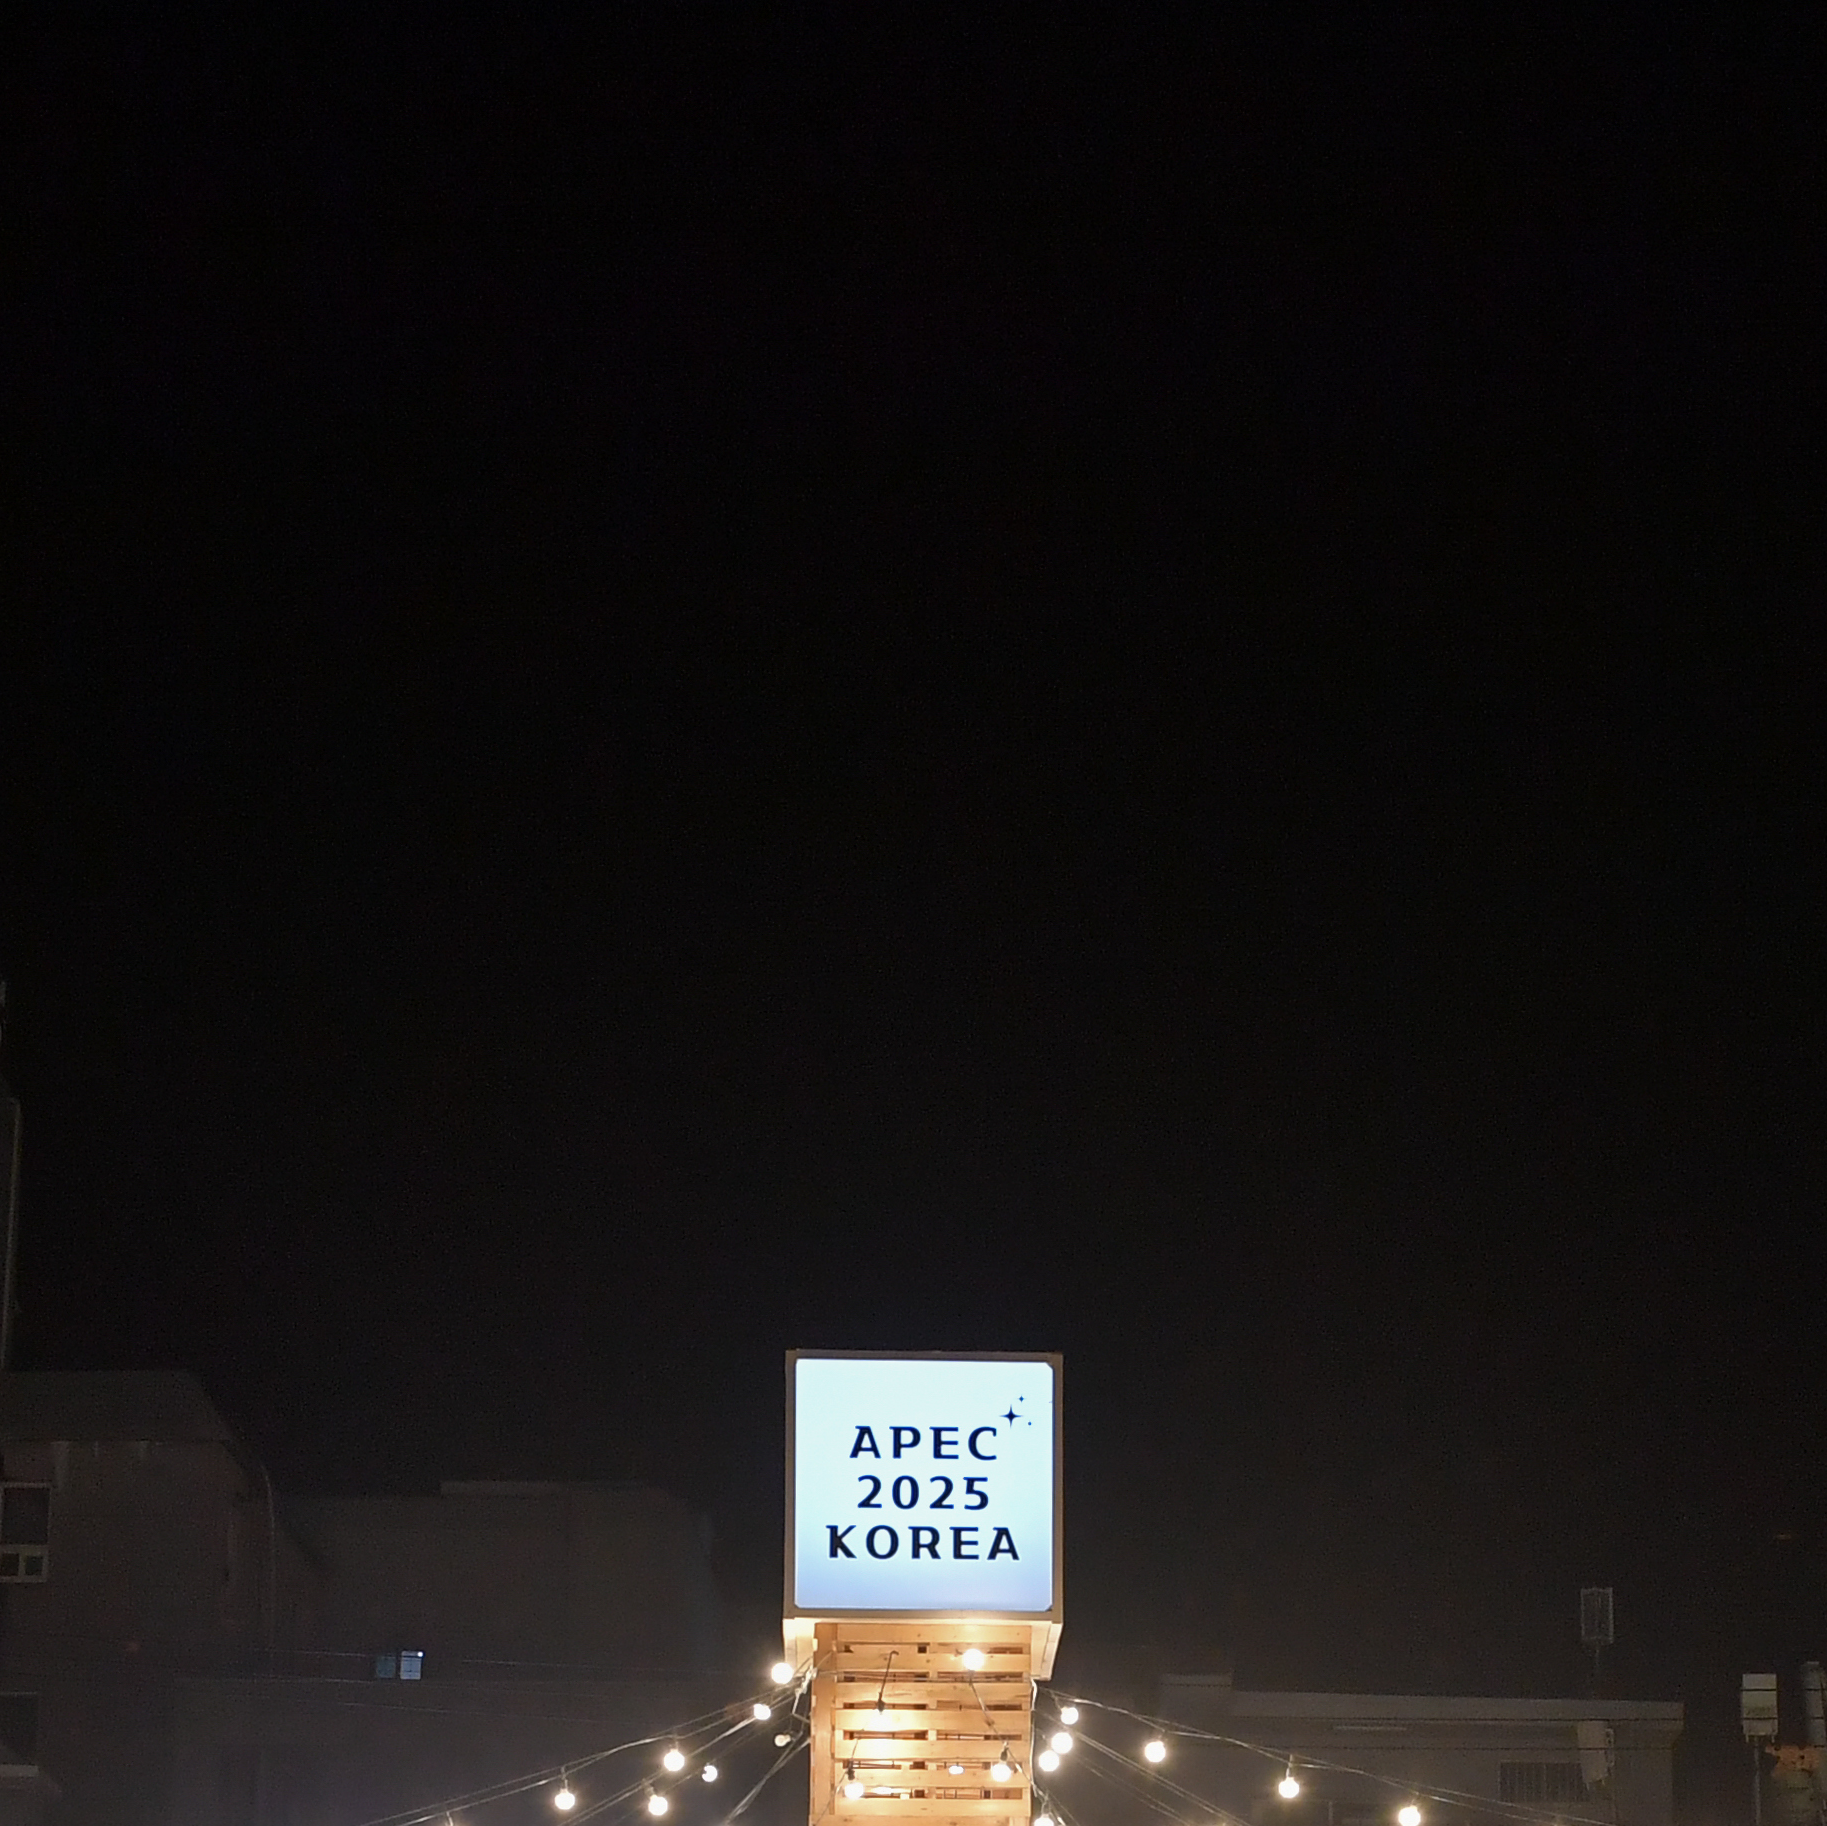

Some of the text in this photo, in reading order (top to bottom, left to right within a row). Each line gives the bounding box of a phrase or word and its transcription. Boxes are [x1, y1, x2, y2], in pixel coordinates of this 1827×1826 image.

[849, 1425, 998, 1461] APEC
[856, 1474, 990, 1511] 2025
[825, 1524, 1021, 1561] KOREA
